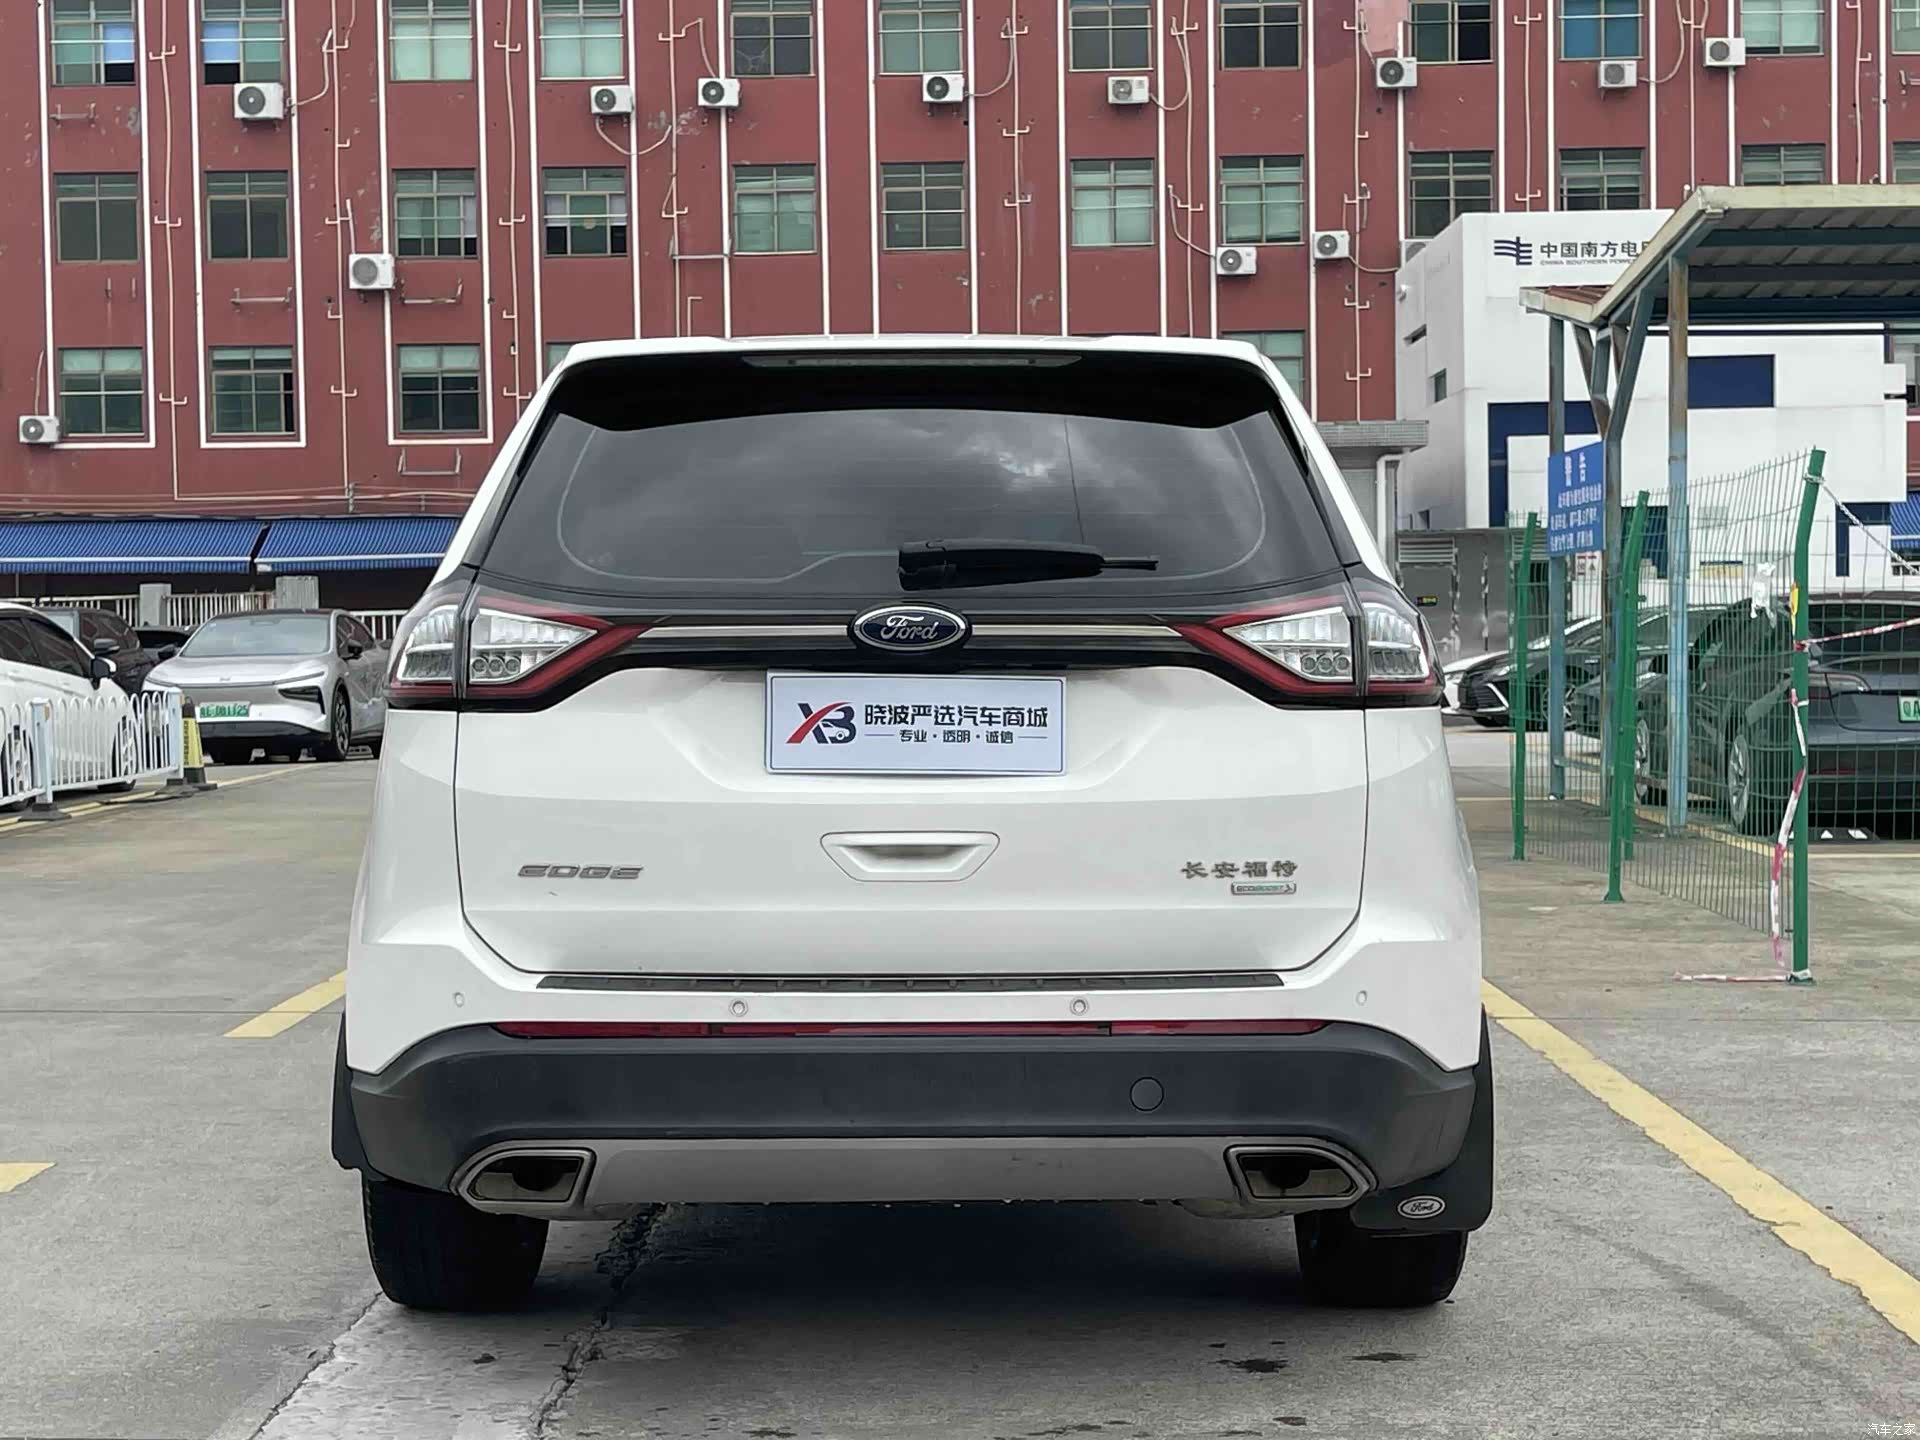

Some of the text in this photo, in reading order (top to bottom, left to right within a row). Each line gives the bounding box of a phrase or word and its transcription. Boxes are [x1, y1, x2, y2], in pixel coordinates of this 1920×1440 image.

[880, 615, 940, 640] Ford
[864, 704, 1048, 728] 晓波严选汽车商城
[518, 865, 643, 880] EDGE
[1181, 860, 1298, 879] 长安福特
[1410, 1201, 1435, 1213] Ford
